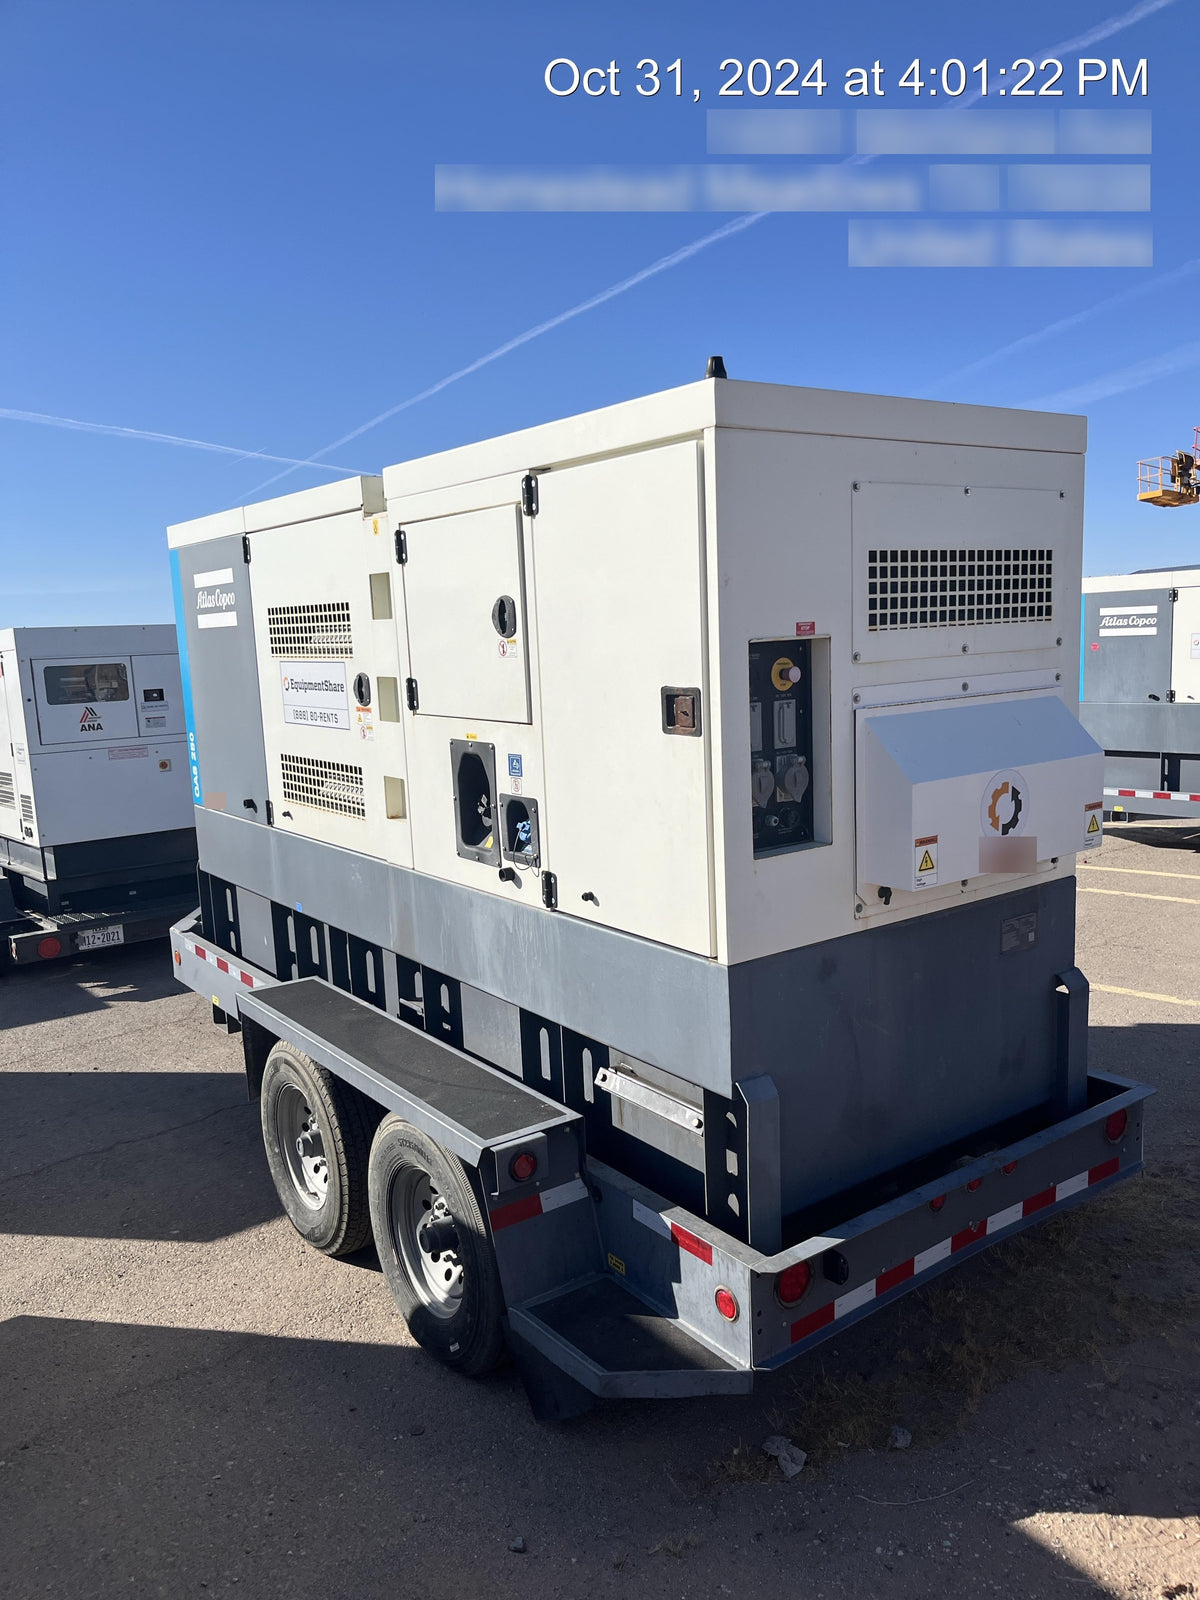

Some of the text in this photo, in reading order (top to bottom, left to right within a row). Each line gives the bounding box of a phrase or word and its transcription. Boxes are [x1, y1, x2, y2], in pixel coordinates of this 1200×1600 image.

[197, 588, 236, 610] Atlas Copco
[1099, 615, 1158, 627] Atlas Copco
[290, 678, 345, 693] EquipmentShare
[293, 709, 339, 723] (888) 80-RENTS
[80, 722, 103, 733] ANA
